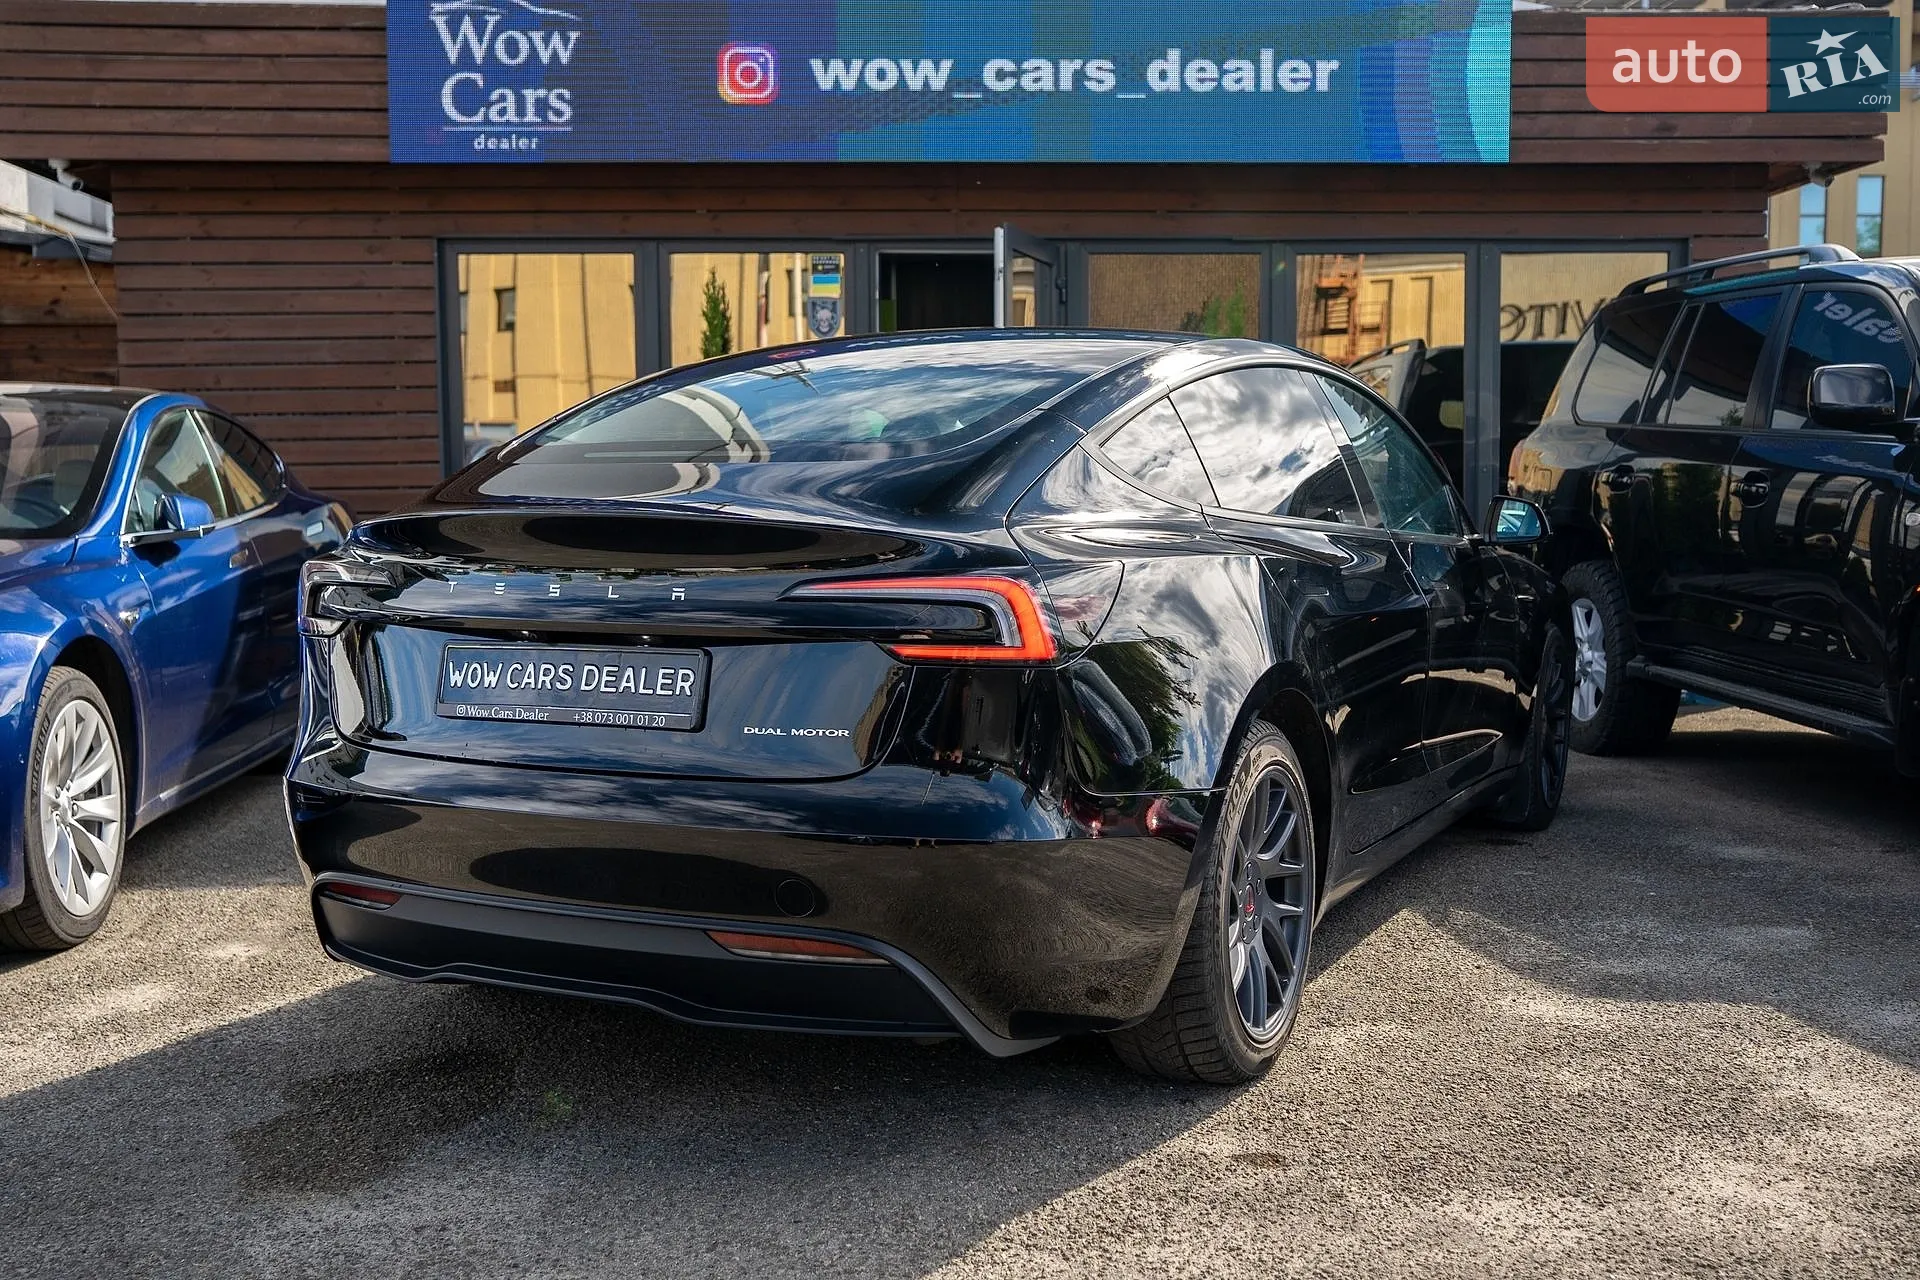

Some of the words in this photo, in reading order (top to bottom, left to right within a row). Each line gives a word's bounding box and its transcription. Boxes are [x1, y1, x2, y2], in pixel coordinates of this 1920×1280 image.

[430, 13, 581, 65] Wow
[809, 48, 1340, 98] wow_cars_dealer
[441, 72, 574, 125] Cars
[474, 133, 539, 151] dealer
[448, 581, 686, 601] TESLA
[448, 660, 503, 689] WOW
[506, 662, 574, 692] CARS
[580, 665, 696, 697] DEALER
[573, 711, 593, 723] +38
[595, 711, 614, 724] 073
[616, 712, 634, 725] 001
[637, 714, 651, 725] 01
[652, 715, 666, 727] 20
[743, 727, 787, 736] DUAL
[791, 728, 850, 737] MOTOR
